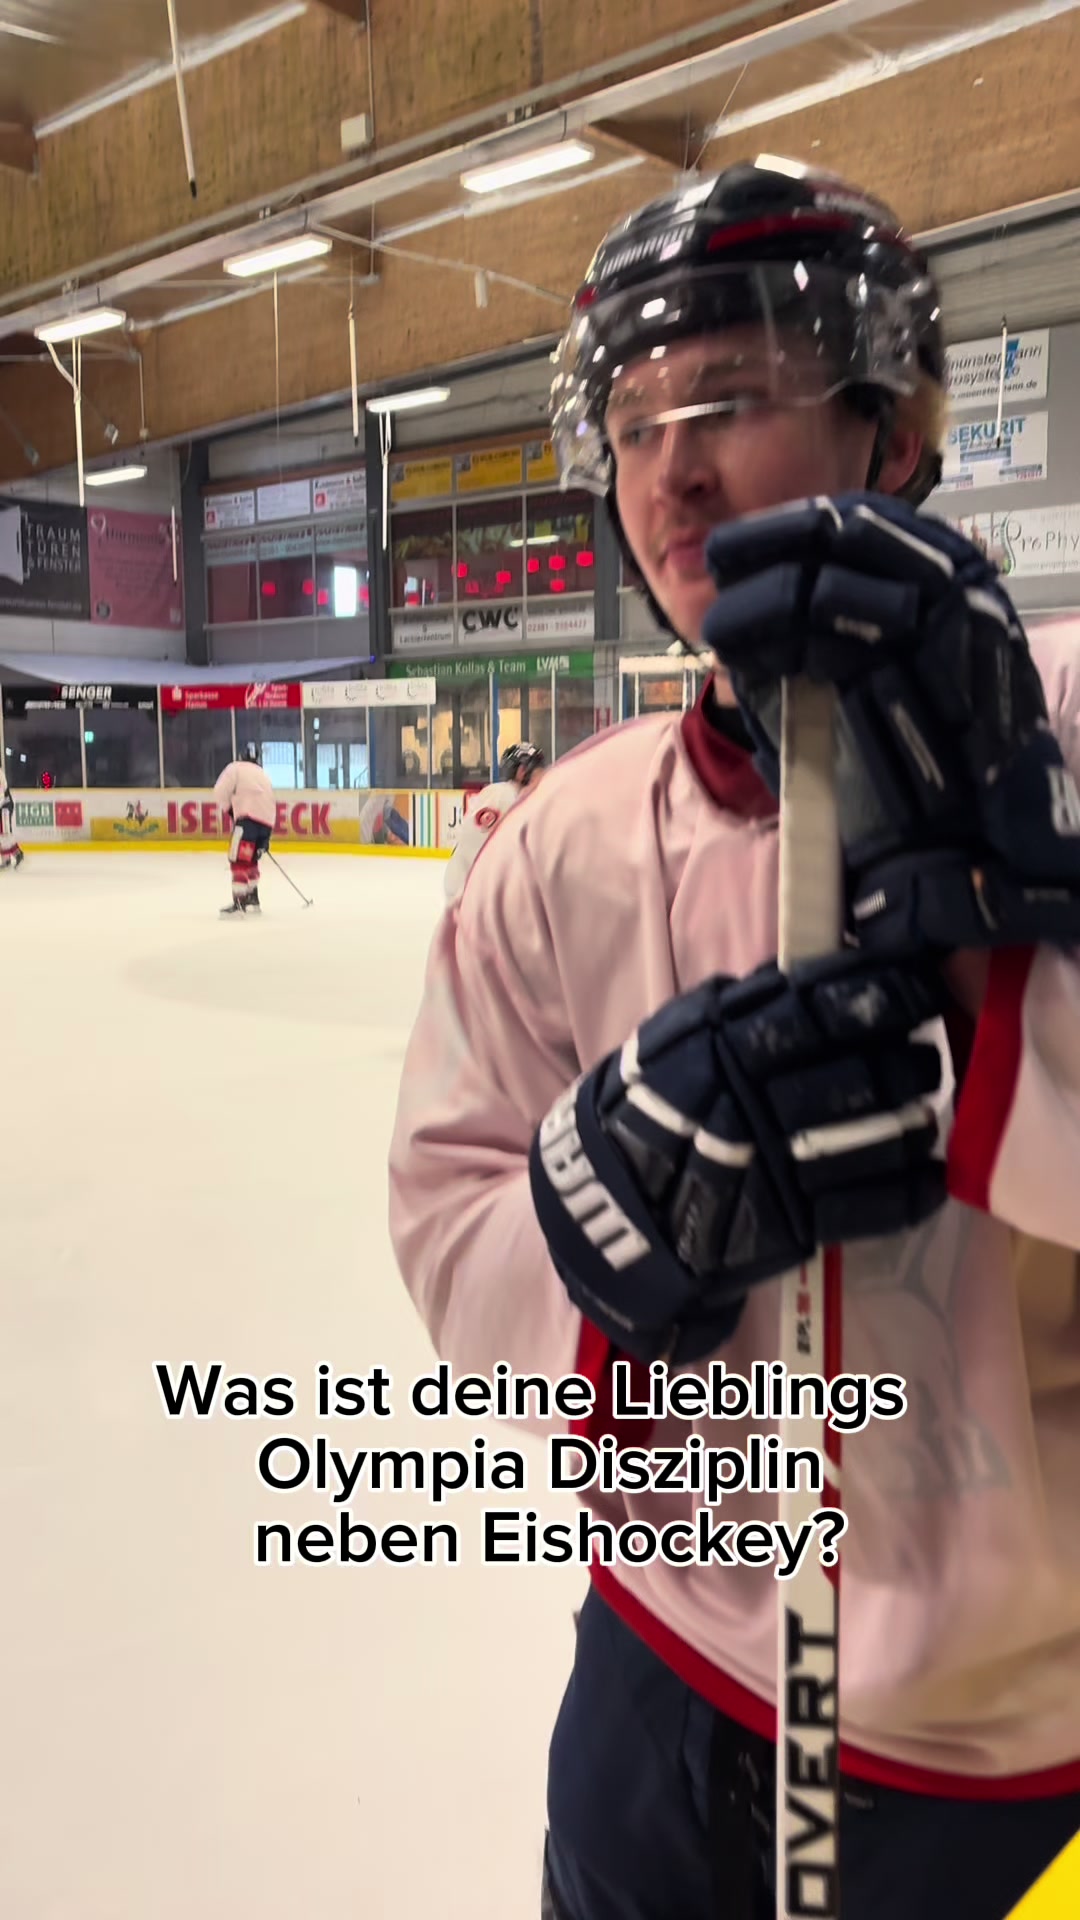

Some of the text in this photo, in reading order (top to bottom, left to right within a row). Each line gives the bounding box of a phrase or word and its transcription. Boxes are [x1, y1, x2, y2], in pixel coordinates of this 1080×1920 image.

[948, 417, 1025, 446] SEKURIT
[26, 523, 81, 542] TRAUM
[37, 555, 81, 573] FENSTER
[462, 606, 519, 632] CWC
[405, 655, 560, 678] Sebastian Kollas & Team LVM
[61, 685, 112, 700] SENGER
[18, 803, 50, 817] HGB
[167, 801, 331, 836] ISEECK
[786, 1606, 838, 1918] OVERT
